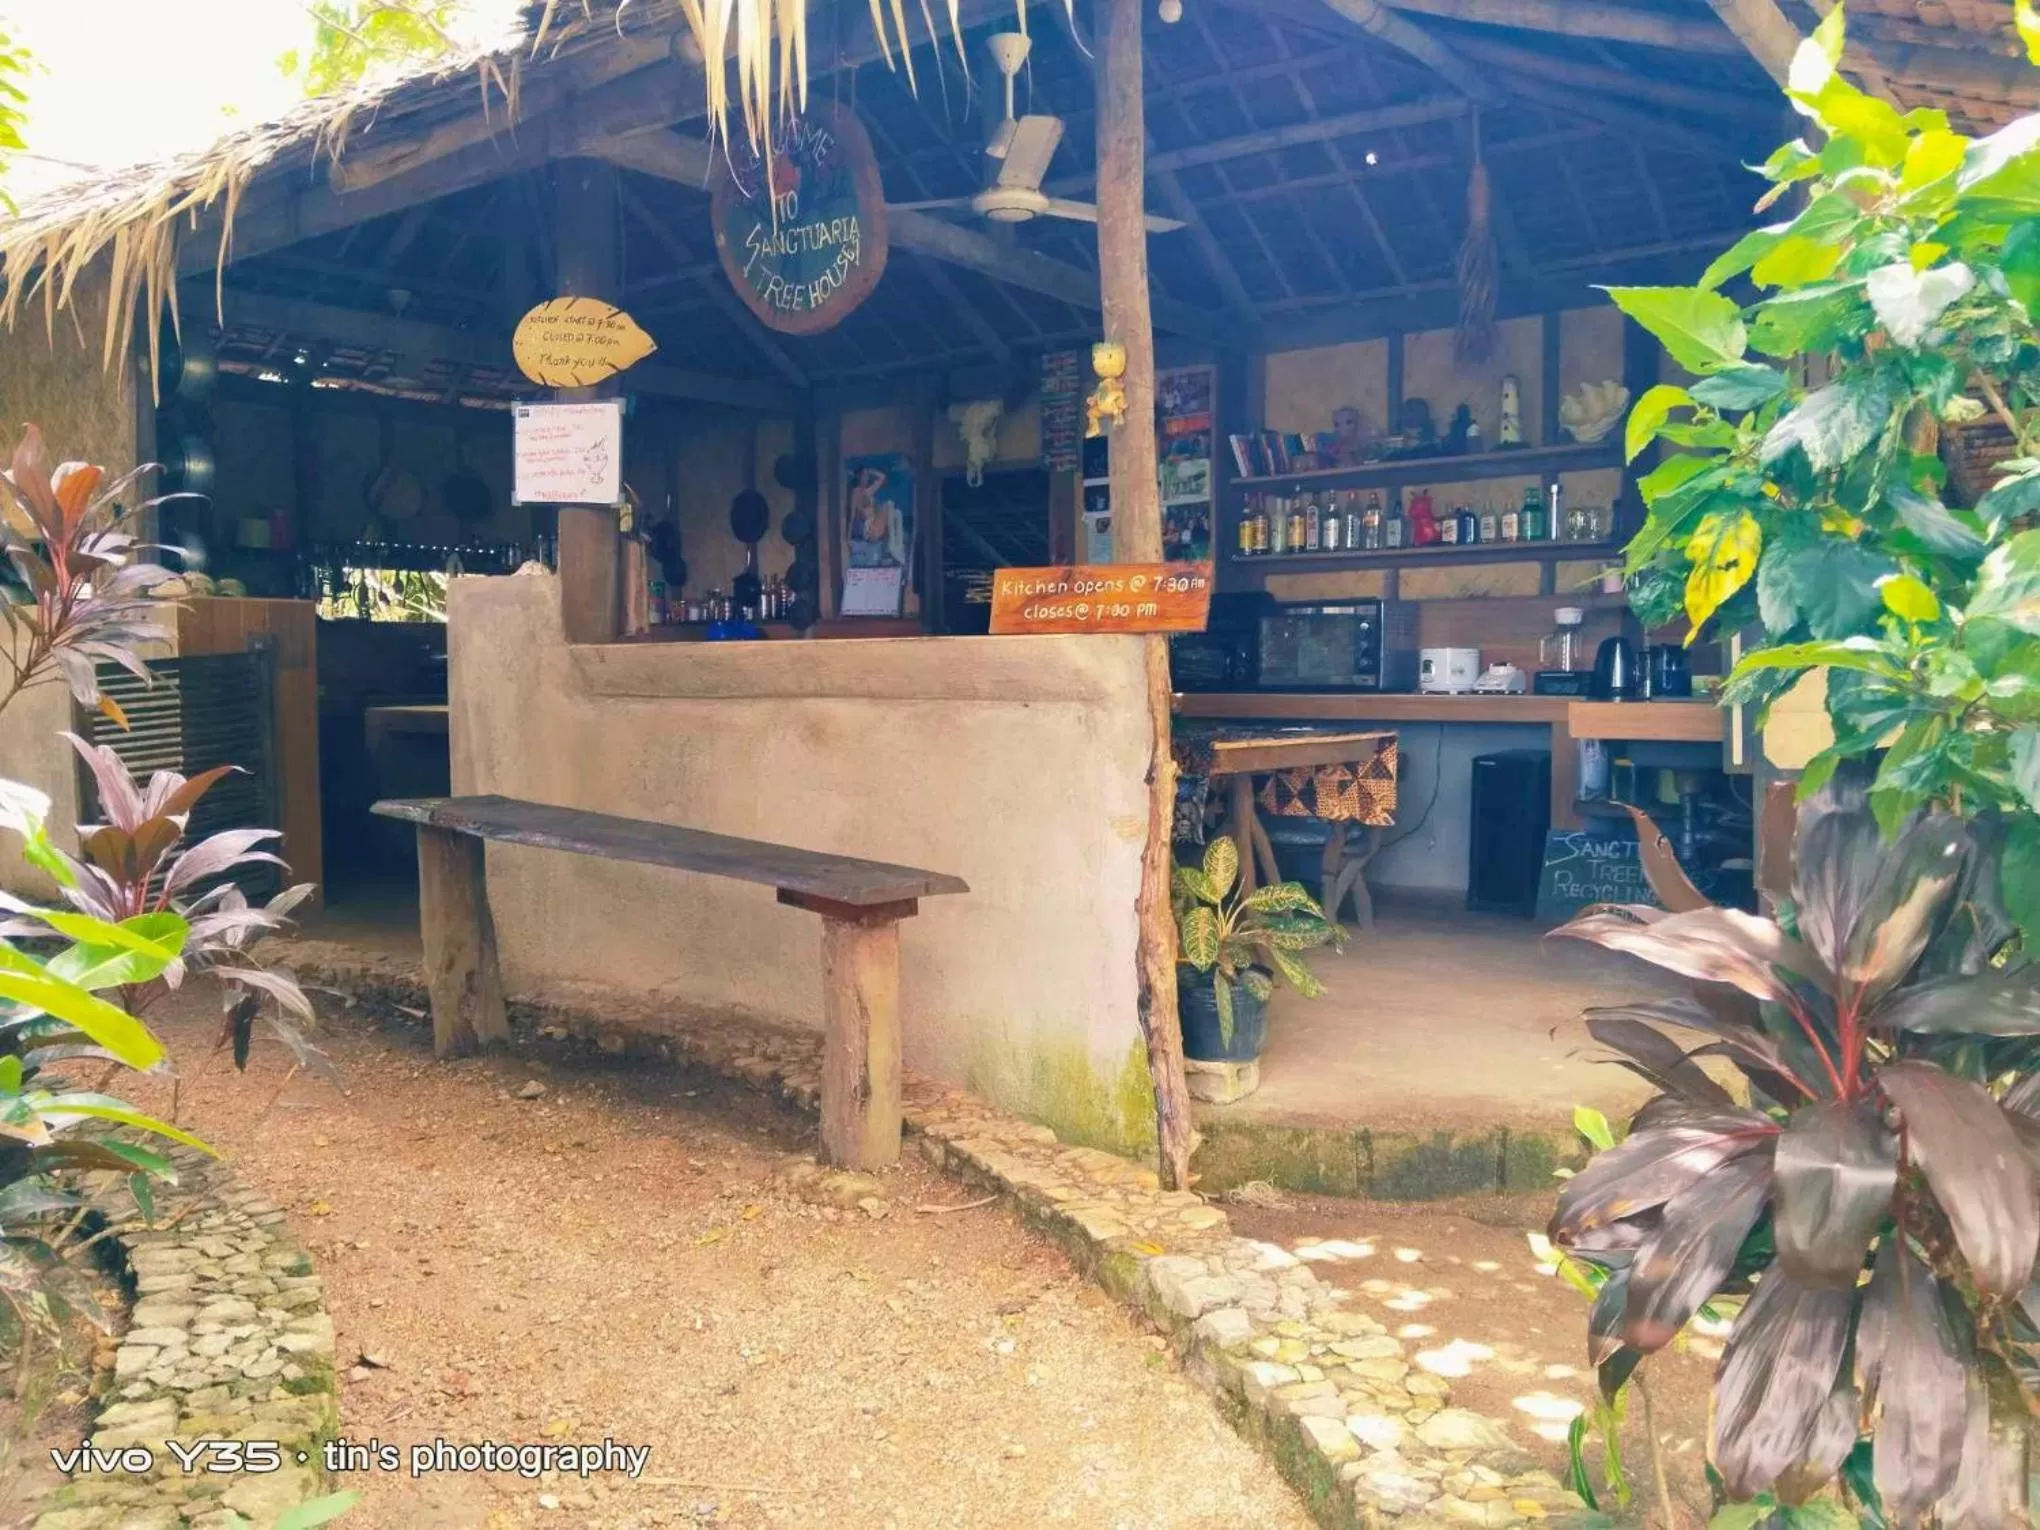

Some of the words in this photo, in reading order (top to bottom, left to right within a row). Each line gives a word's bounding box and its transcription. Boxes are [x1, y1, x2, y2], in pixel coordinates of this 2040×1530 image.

[775, 190, 798, 223] TO
[744, 216, 860, 278] SANCTUARIA
[542, 331, 574, 343] CLOSED
[539, 352, 570, 366] Thank
[1001, 579, 1068, 597] Kitchen
[1074, 578, 1124, 597] opens
[1130, 575, 1146, 593] @
[1136, 603, 1158, 618] PM
